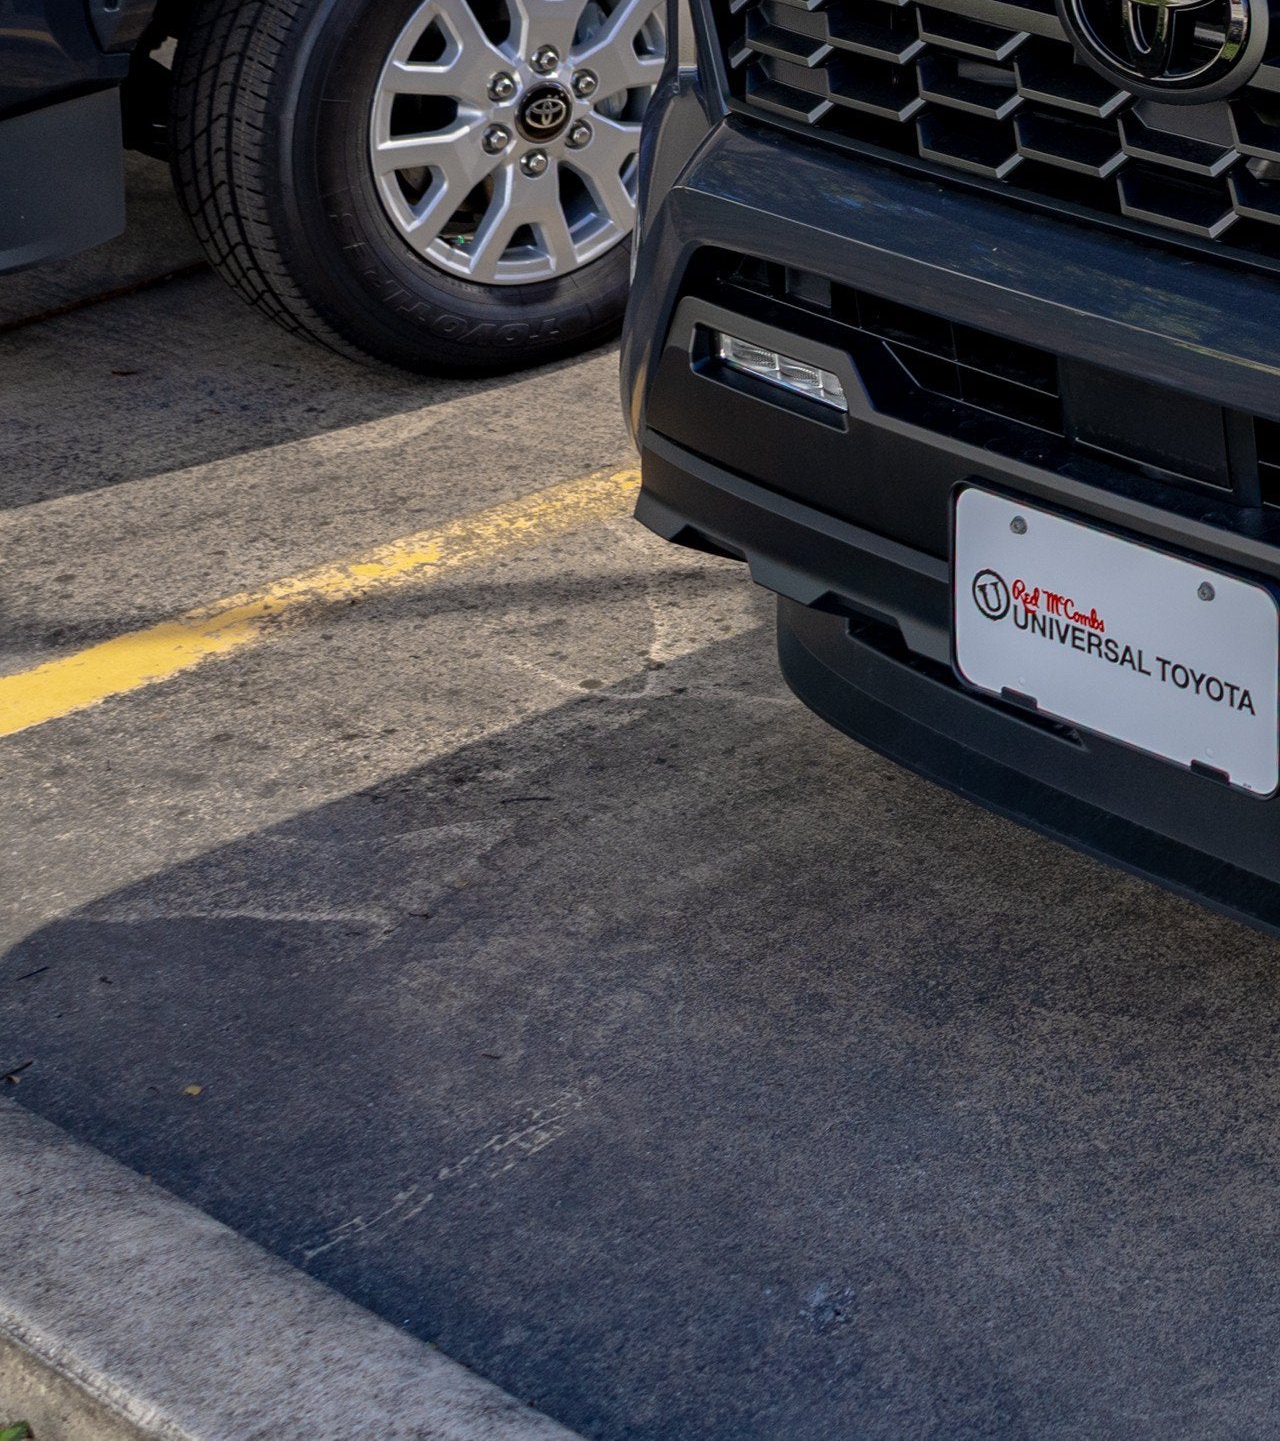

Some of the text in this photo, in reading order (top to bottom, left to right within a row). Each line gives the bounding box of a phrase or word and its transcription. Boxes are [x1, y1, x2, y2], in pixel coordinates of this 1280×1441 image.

[1012, 579, 1106, 633] Red McCombs
[1012, 604, 1257, 716] UNIVERSAL TOYOTA
